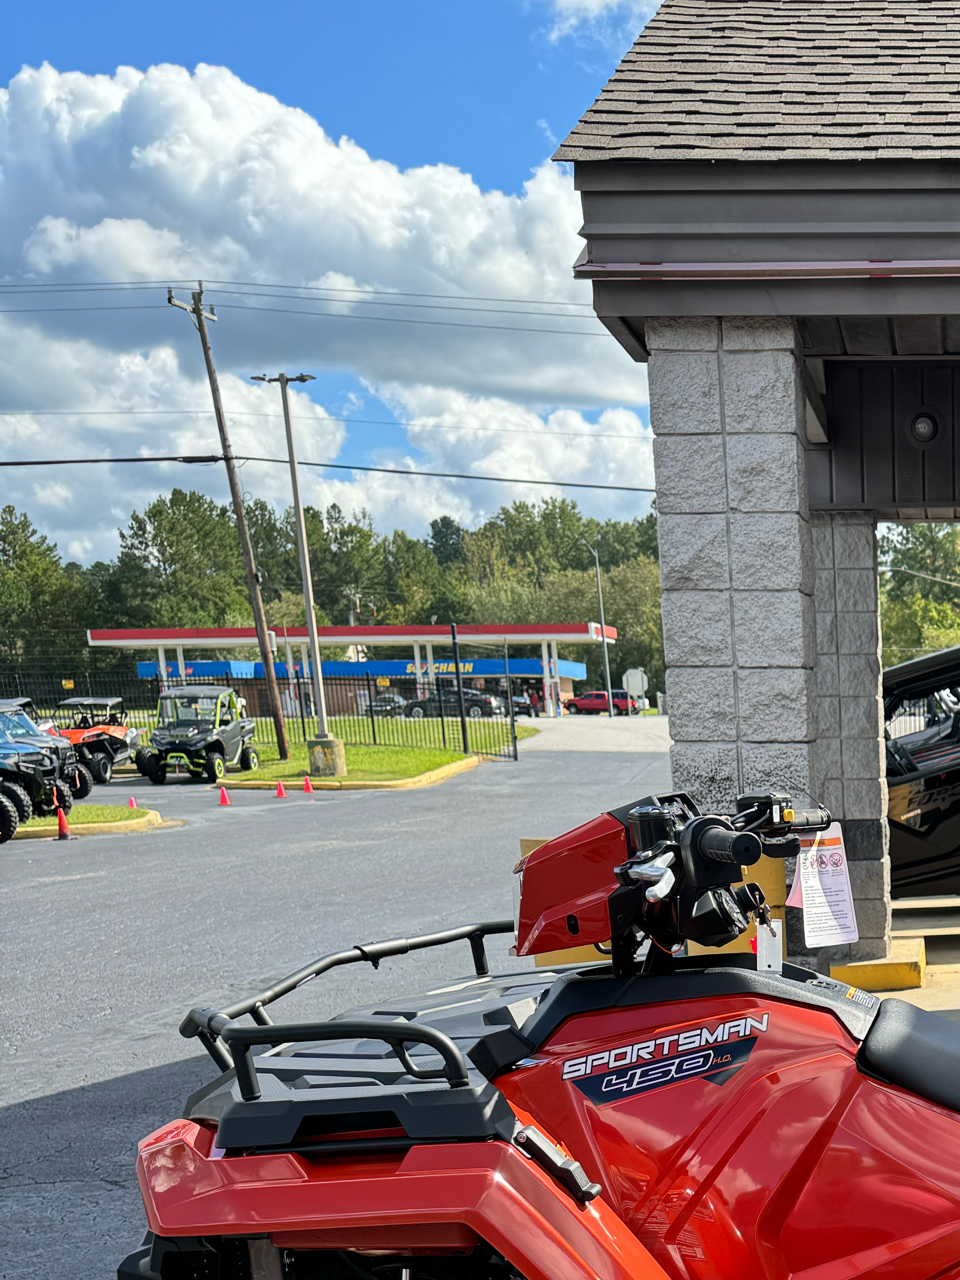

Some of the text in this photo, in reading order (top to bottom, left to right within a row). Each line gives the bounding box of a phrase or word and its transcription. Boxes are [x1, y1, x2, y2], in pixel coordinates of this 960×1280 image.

[562, 1012, 770, 1080] SPORTSMAN
[601, 1050, 732, 1092] 450 H.O.
